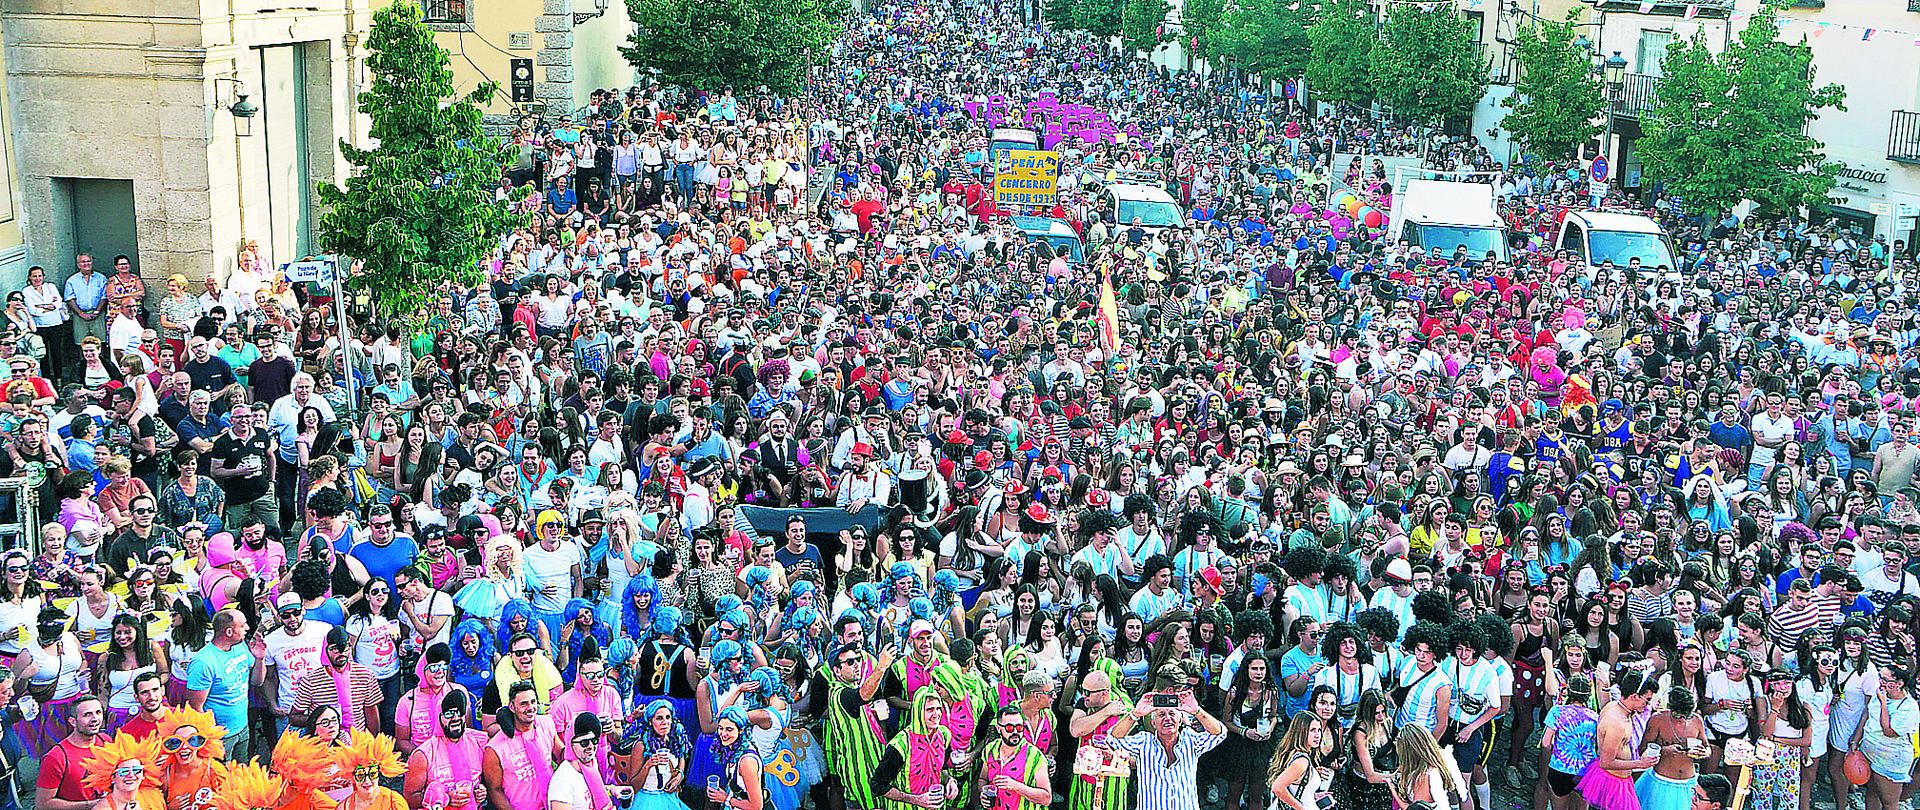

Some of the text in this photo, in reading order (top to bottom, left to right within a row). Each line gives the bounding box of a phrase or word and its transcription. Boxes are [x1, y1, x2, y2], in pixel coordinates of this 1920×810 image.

[1012, 156, 1044, 168] PEÑA
[1000, 179, 1051, 189] CENCERRO
[1000, 193, 1031, 203] DESDE
[1604, 437, 1621, 448] USA
[1543, 447, 1559, 458] USA
